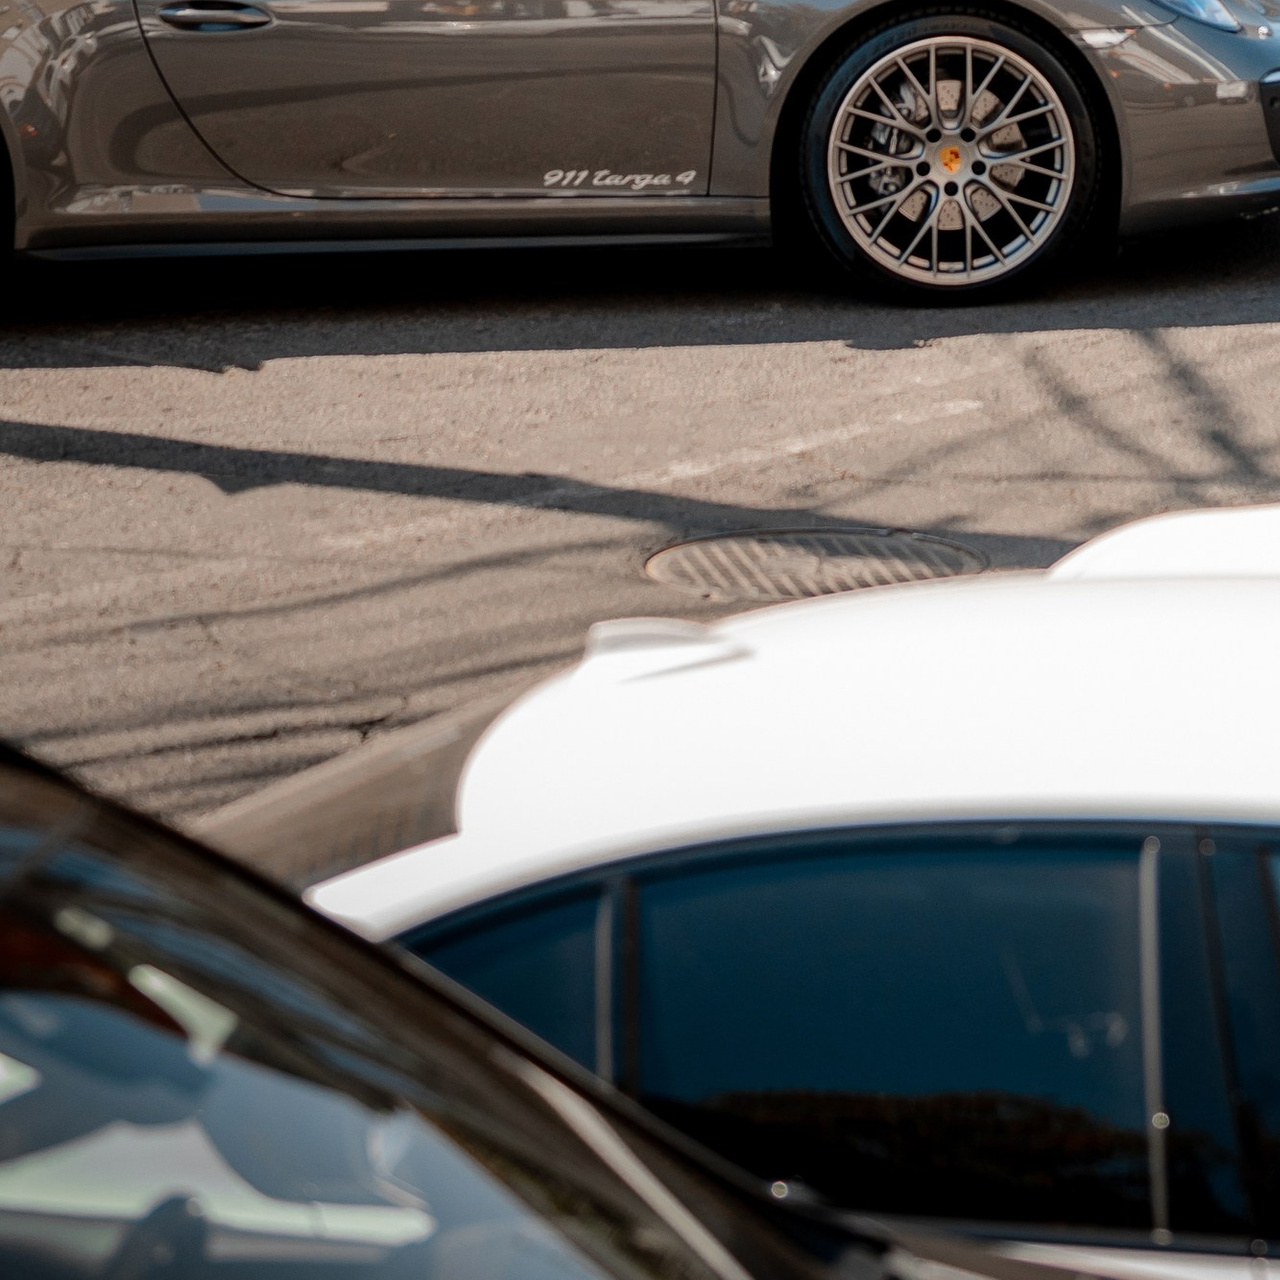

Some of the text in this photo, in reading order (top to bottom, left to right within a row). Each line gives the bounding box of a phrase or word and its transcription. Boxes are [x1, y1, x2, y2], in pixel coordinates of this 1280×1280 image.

[543, 168, 697, 190] 911 targa 4
